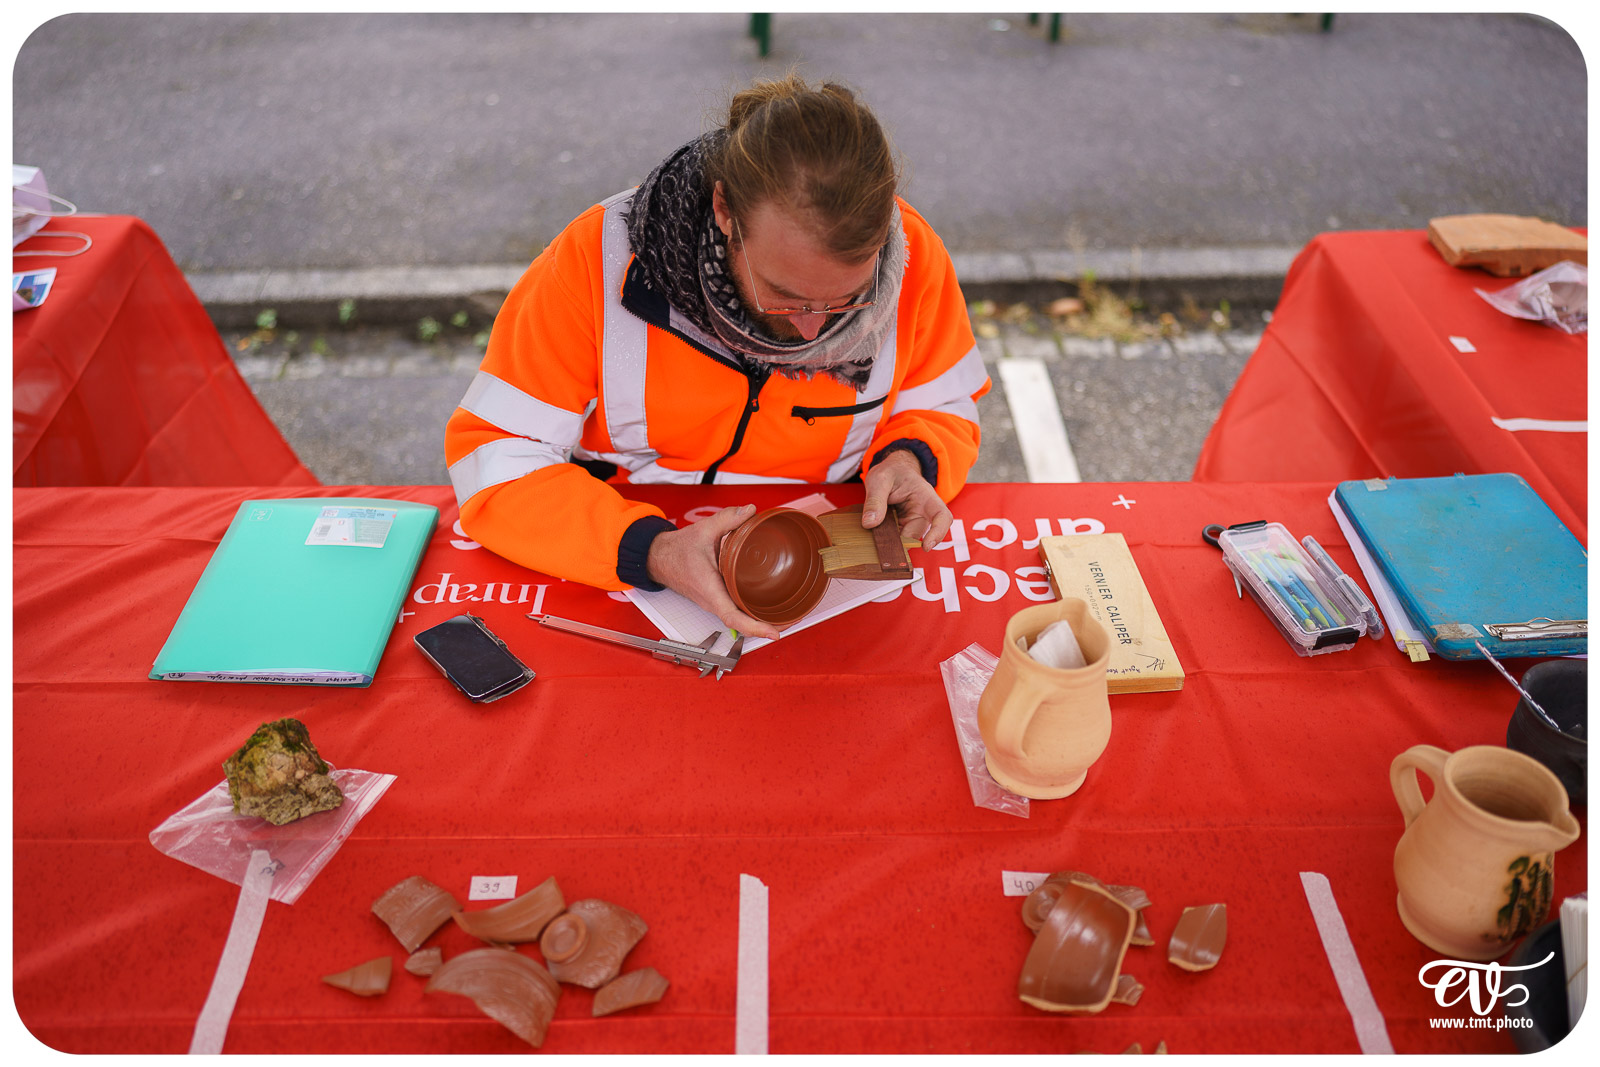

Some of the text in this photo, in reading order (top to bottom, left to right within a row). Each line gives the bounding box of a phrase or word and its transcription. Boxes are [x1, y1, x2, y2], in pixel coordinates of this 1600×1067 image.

[413, 572, 552, 615] Inrap
[1088, 561, 1132, 645] VERNIER CALIPER
[480, 882, 501, 894] 39
[1013, 879, 1035, 893] 40
